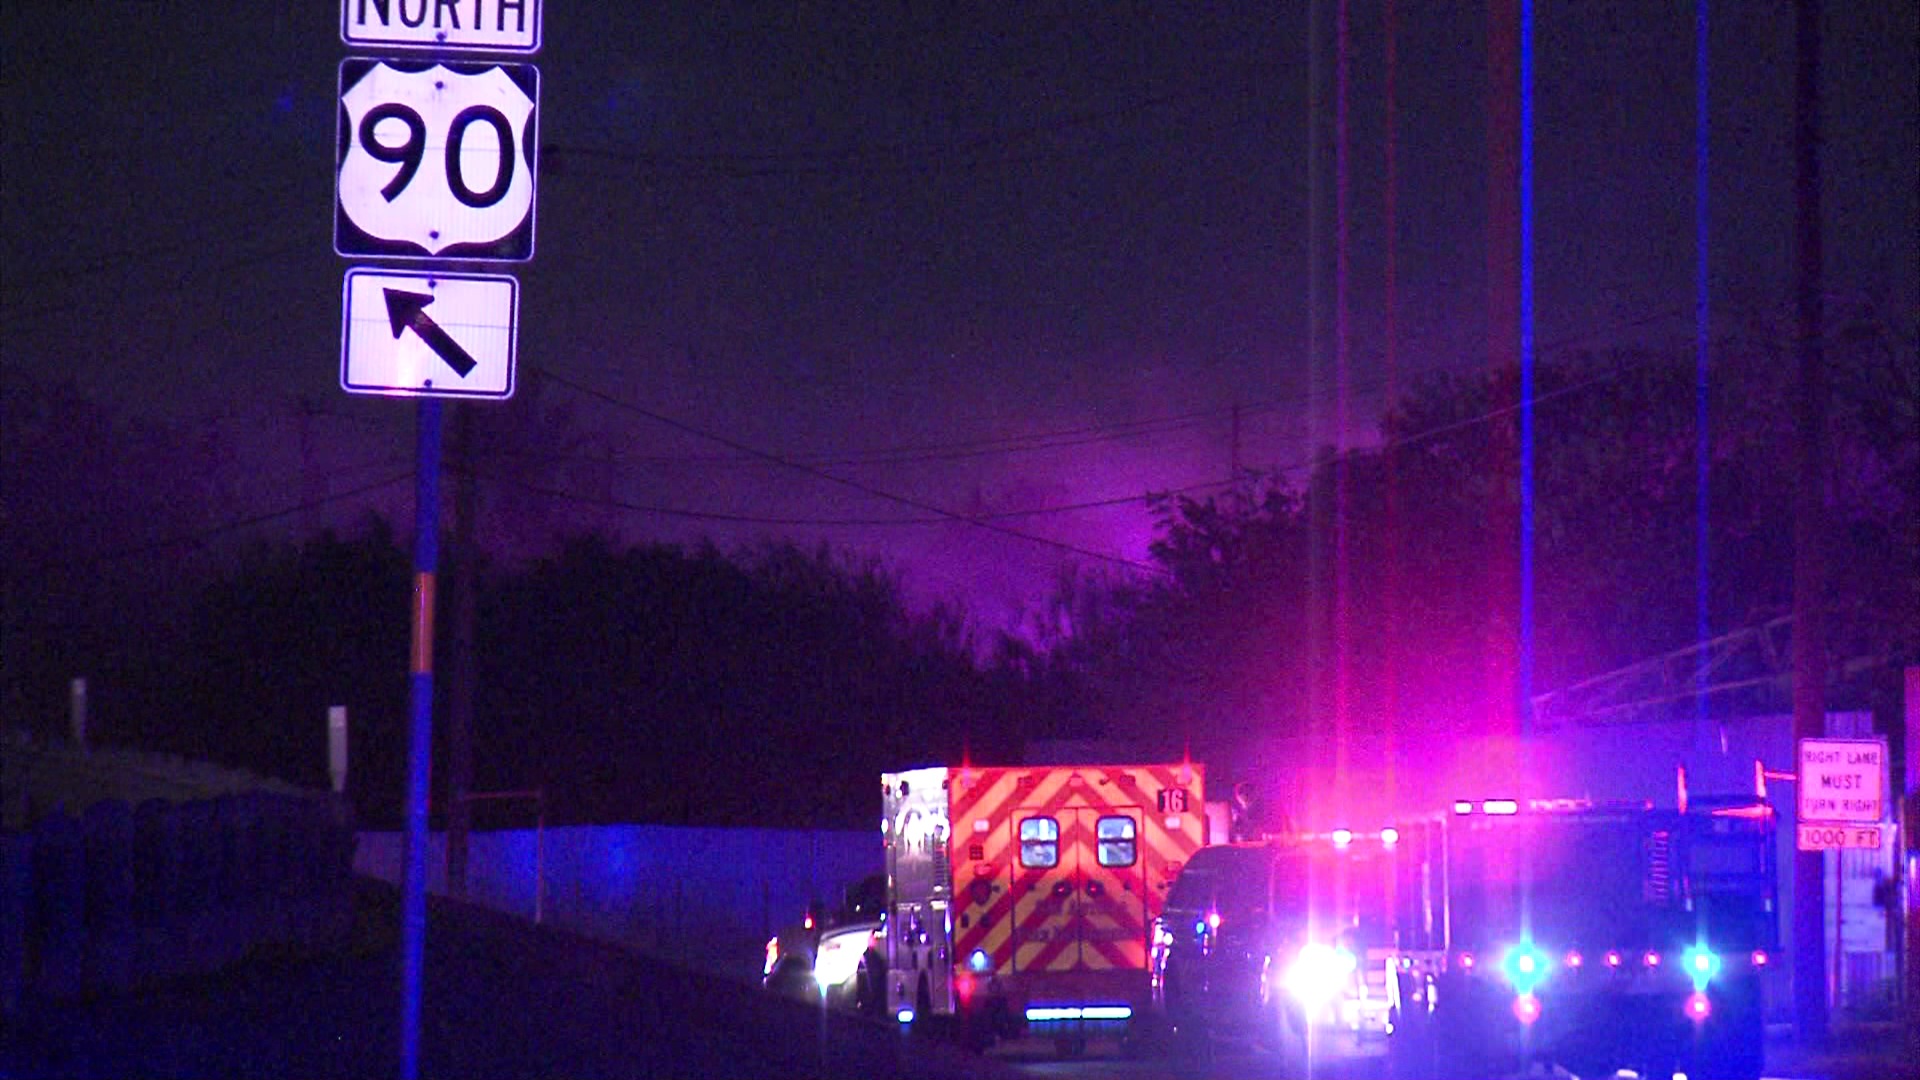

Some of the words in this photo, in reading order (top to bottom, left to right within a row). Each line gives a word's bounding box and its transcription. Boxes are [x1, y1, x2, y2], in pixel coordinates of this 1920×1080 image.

[358, 102, 516, 209] 90
[1804, 750, 1840, 763] RIGHT
[1846, 752, 1879, 765] LANE
[1821, 774, 1862, 789] MUST
[1162, 789, 1184, 812] 16
[1804, 798, 1836, 813] TURN
[1842, 798, 1878, 812] RIGHT
[1804, 828, 1846, 845] 1000
[1856, 830, 1878, 846] FT
